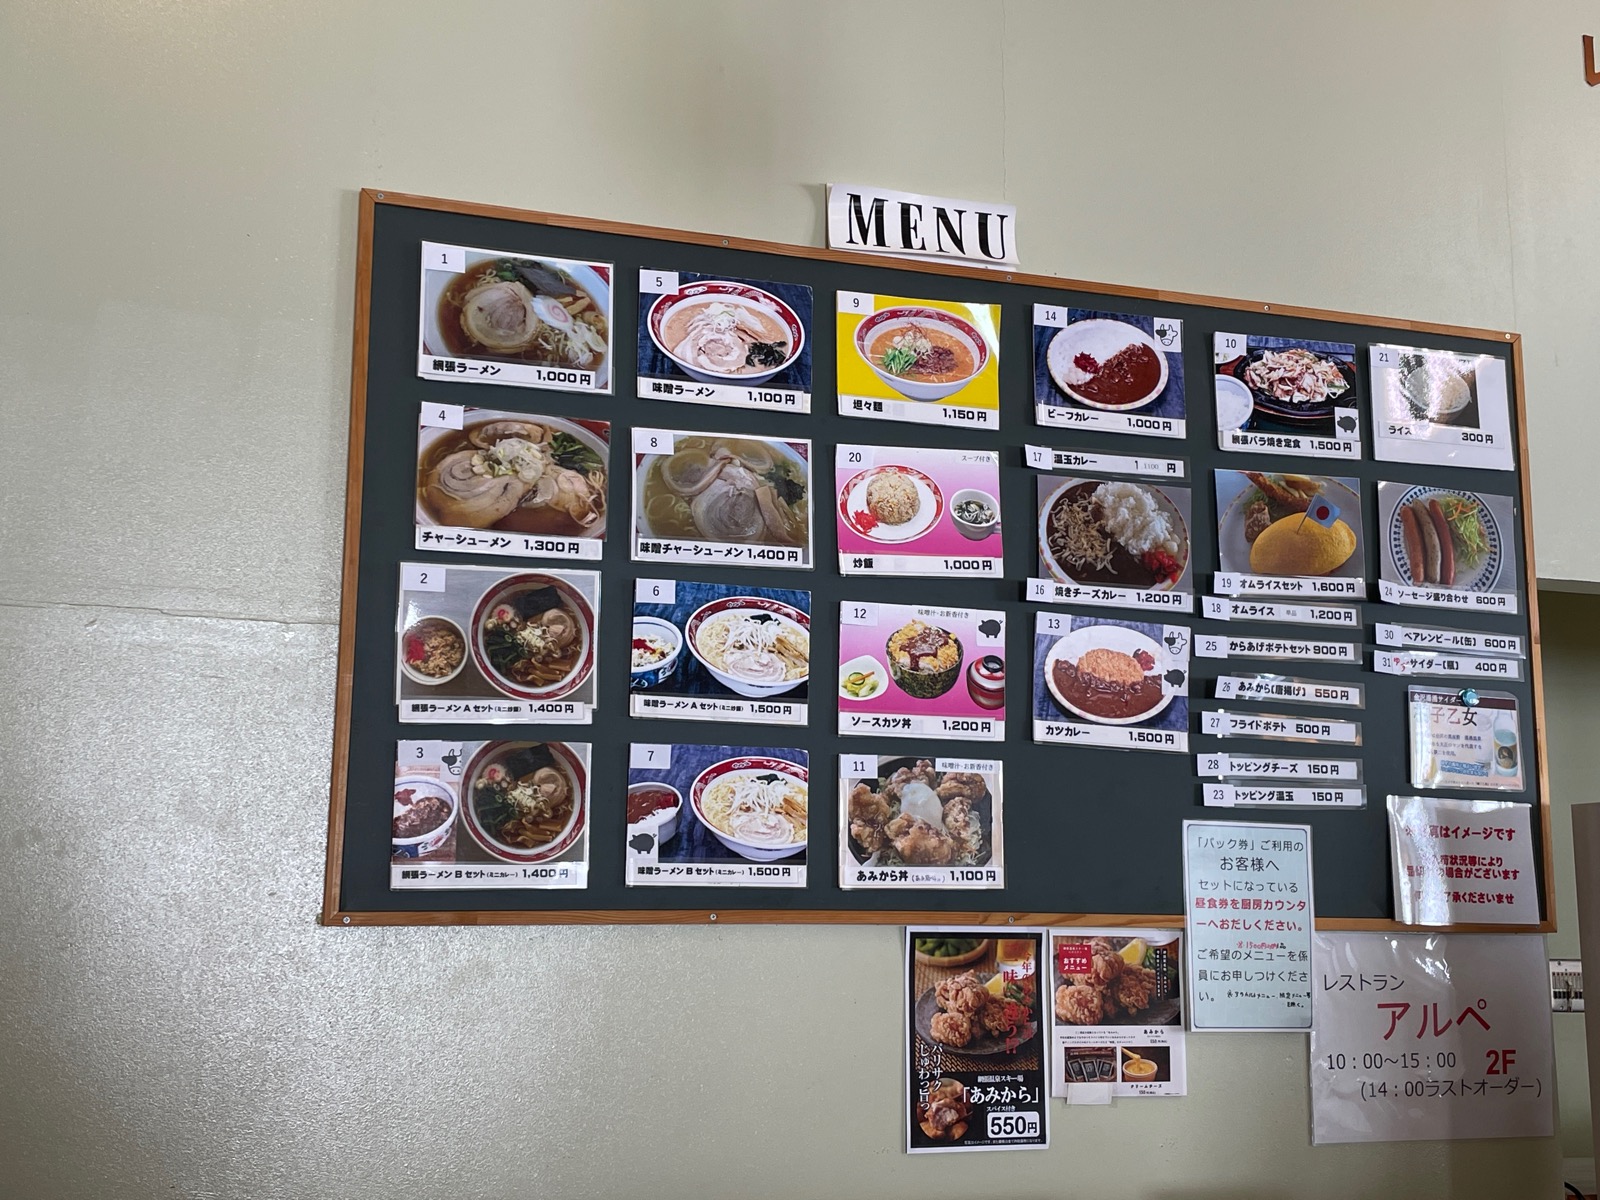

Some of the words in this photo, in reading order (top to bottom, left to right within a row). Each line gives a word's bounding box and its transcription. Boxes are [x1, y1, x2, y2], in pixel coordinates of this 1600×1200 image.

[846, 193, 1009, 260] MENU
[441, 253, 448, 264] 1
[656, 276, 663, 288] 5
[853, 298, 860, 308] 9
[1045, 310, 1057, 321] 14
[1225, 338, 1237, 349] 10
[1379, 353, 1389, 363] 21
[536, 370, 591, 385] 1,000円
[652, 382, 715, 397] 味噌ラーメン
[747, 391, 796, 405] 1,100円
[438, 410, 446, 421] 4
[943, 408, 987, 422] 1,150円
[1047, 409, 1099, 422] ビーフカレー
[1127, 417, 1172, 431] 1,000円
[1388, 426, 1412, 436] ライス
[1461, 432, 1494, 445] 300円
[650, 438, 658, 448] 8
[1309, 440, 1352, 453] 1,500円
[849, 452, 862, 463] 20
[961, 455, 991, 463] スープ付き
[1033, 452, 1042, 462] 17
[1054, 454, 1098, 466] 温玉カレー
[422, 531, 511, 548] チャーシューメン
[524, 539, 579, 555] 1,300円
[640, 542, 744, 557] 味噌チャーシューメン
[747, 548, 798, 562] 1,400円
[853, 558, 874, 569] 炒飯
[944, 559, 993, 571] 1,000円
[420, 573, 428, 584] 2
[653, 585, 660, 596] 6
[1221, 578, 1232, 588] 19
[1239, 579, 1303, 592] オムライスセット
[1312, 582, 1355, 594] 1,600円
[1035, 584, 1045, 595] 16
[1055, 586, 1127, 600] 焼きチーズカレー
[1137, 592, 1182, 605] 1,200円
[1385, 587, 1393, 597] 24
[1397, 589, 1469, 604] ソーセージ盛り合わせ
[1476, 596, 1506, 607] 600円
[854, 608, 867, 619] 12
[1212, 603, 1221, 613] 18
[1231, 605, 1275, 616] オムライス
[1310, 609, 1353, 621] 1,200円
[1048, 619, 1060, 629] 13
[1384, 630, 1394, 639] 30
[1484, 639, 1516, 650] 600円
[1205, 641, 1217, 651] 25
[1229, 641, 1310, 655] からあげポテトセット
[1313, 645, 1347, 657] 900円
[1382, 658, 1391, 668] 31
[1475, 663, 1507, 674] 400円
[1222, 682, 1230, 692] 26
[1314, 689, 1349, 701] 550円
[529, 703, 574, 714] 1,400円
[750, 704, 792, 715] 1,500円
[851, 716, 912, 729] ソースカツ丼
[942, 720, 991, 732] 1,200円
[1211, 717, 1220, 728] 27
[1229, 719, 1287, 732] フライドポテト
[1295, 724, 1331, 736] 500円
[1046, 725, 1090, 738] カツカレー
[1128, 731, 1174, 745] 1,500円
[417, 747, 424, 758] 3
[649, 750, 655, 761] 7
[853, 761, 866, 772] 11
[1207, 759, 1219, 770] 28
[1230, 761, 1298, 774] トッピングチーズ
[1307, 764, 1339, 775] 150円
[1213, 789, 1224, 800] 23
[1235, 790, 1294, 802] トッピング温玉
[1311, 792, 1344, 803] 150円
[1405, 825, 1515, 841] ※真はイメージです
[1220, 856, 1280, 872] お客様へ
[748, 867, 791, 877] 1,500円
[856, 870, 909, 883] あみから丼
[950, 870, 996, 882] 1,100円
[1198, 879, 1299, 893] セットになっている
[1195, 897, 1306, 911] 昼食券を厨房カウンタ
[1196, 919, 1303, 932] ーへおだしください。
[1063, 957, 1088, 965] おすすめ
[1197, 949, 1308, 962] ご希望のメニューを係
[1198, 969, 1308, 982] 員にお申しつけくださ
[1324, 974, 1405, 991] レストラン
[1198, 992, 1215, 1002] い。
[1377, 998, 1491, 1041] アルペ
[932, 1042, 943, 1092] パリサク
[1485, 1050, 1517, 1075] 2F
[963, 1085, 1039, 1105] 「あみから」
[990, 1116, 1038, 1135] 550円
